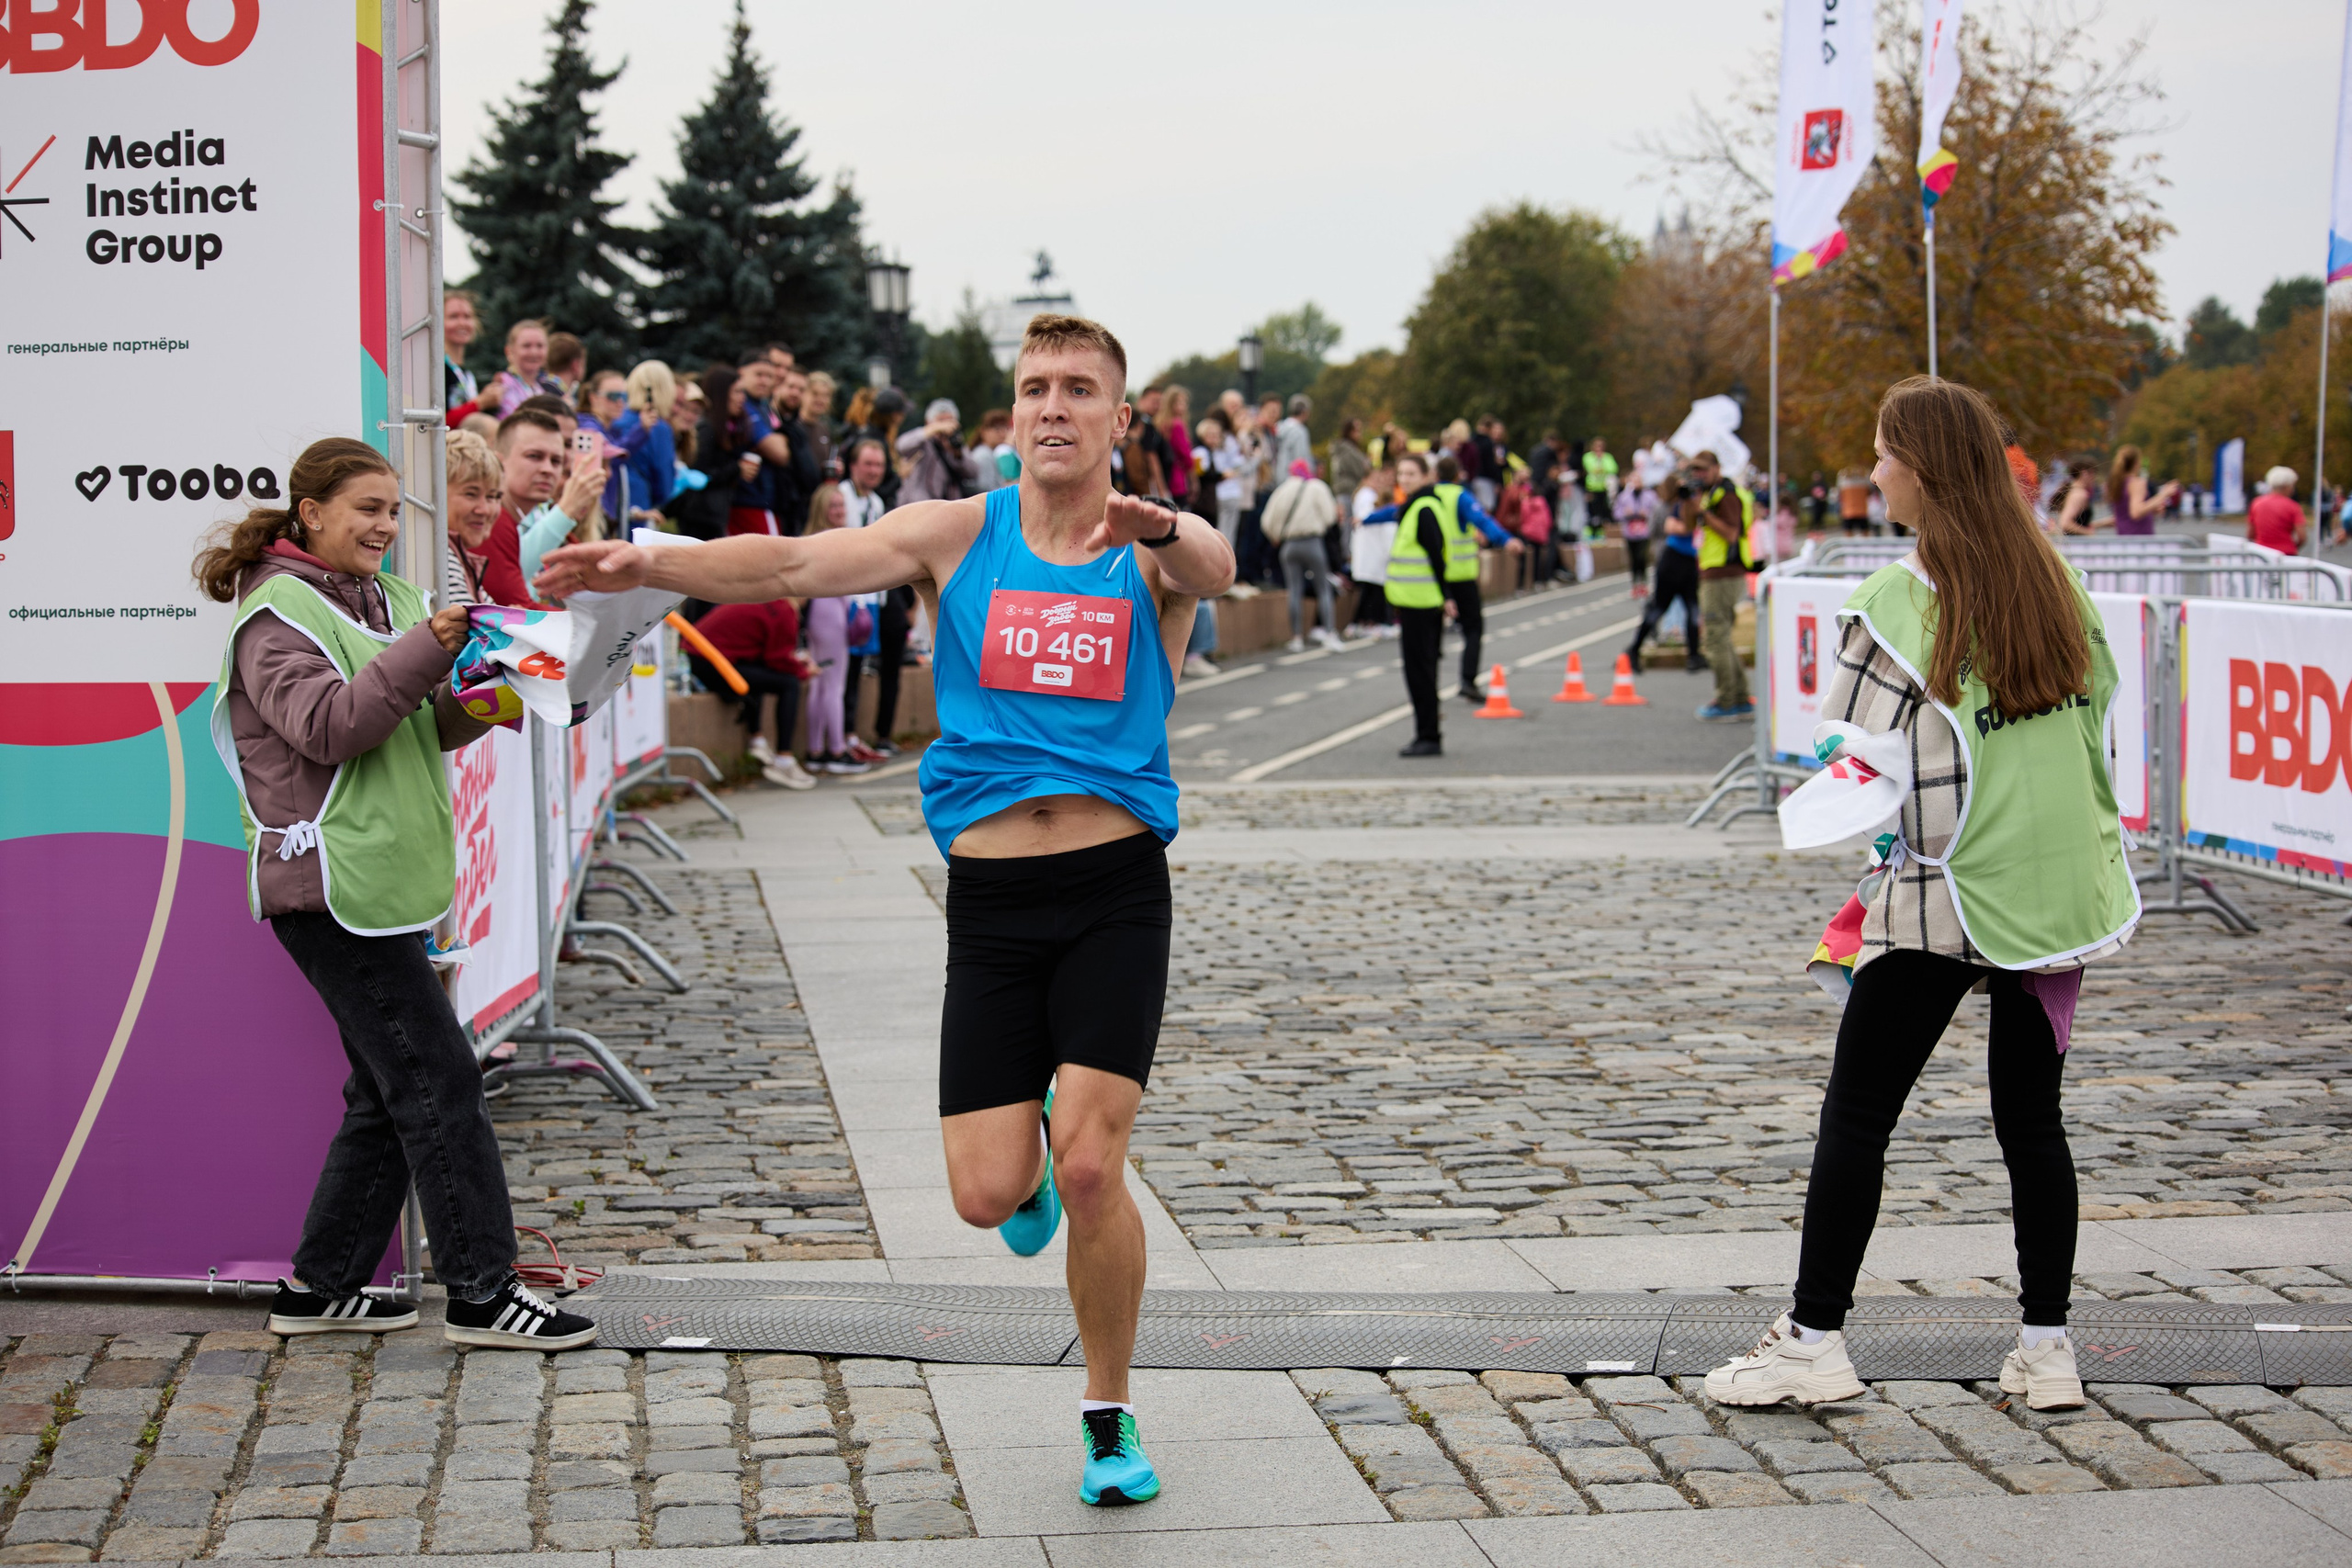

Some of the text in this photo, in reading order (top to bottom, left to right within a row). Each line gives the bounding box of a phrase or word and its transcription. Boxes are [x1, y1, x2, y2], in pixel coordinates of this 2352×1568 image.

[0, 0, 259, 73] BDO
[85, 129, 224, 170] Media
[86, 177, 257, 217] Instinct
[85, 230, 222, 270] Group
[7, 337, 189, 355] генеральные партнёры
[119, 463, 280, 501] Tooba
[8, 604, 197, 621] официальные партнёры
[1081, 611, 1094, 622] 10
[1000, 626, 1113, 665] 10 461
[1041, 670, 1065, 679] BBDO
[2229, 658, 2352, 796] BBD
